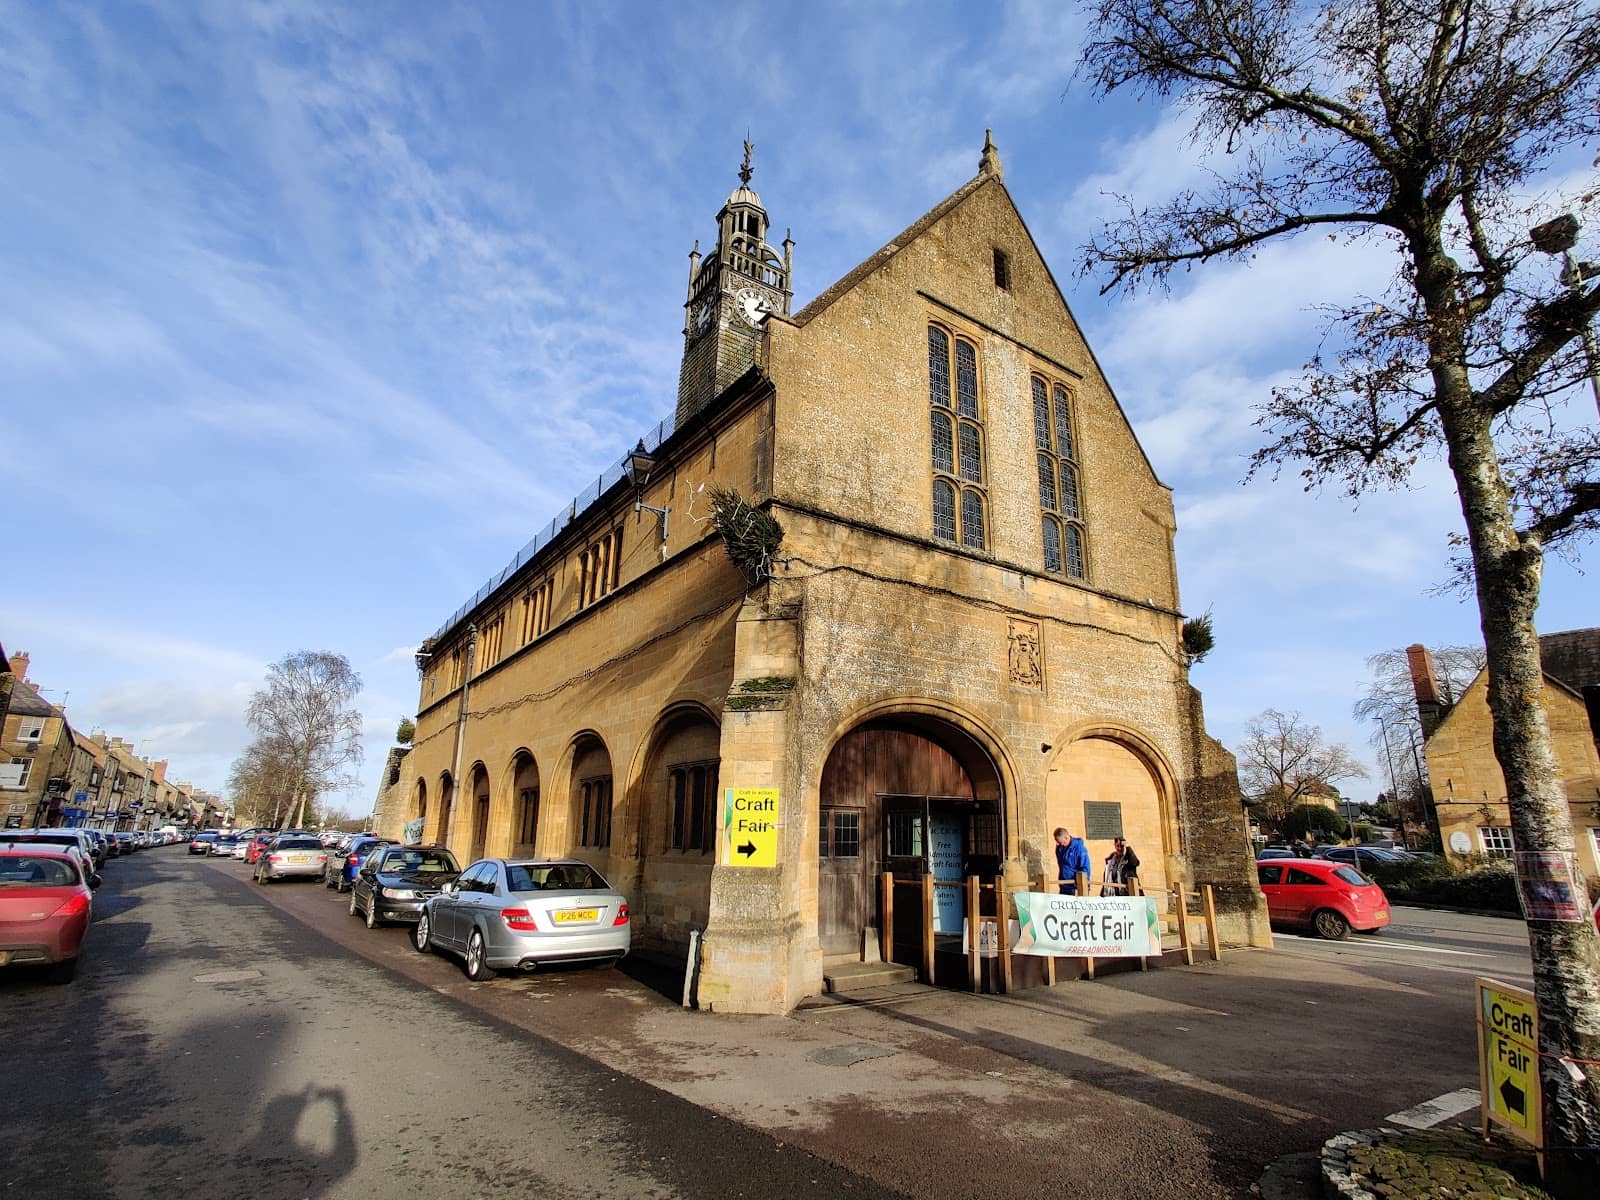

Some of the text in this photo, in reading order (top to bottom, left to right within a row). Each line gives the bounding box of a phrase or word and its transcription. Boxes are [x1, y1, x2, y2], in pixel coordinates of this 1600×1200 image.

[735, 798, 775, 811] Craft
[738, 818, 770, 833] Fair
[936, 841, 953, 849] Free
[1043, 913, 1135, 941] Craft Fair
[1067, 945, 1122, 953] FREE ADMISSION
[1491, 1003, 1534, 1040] Craft
[1497, 1039, 1530, 1073] Fair
